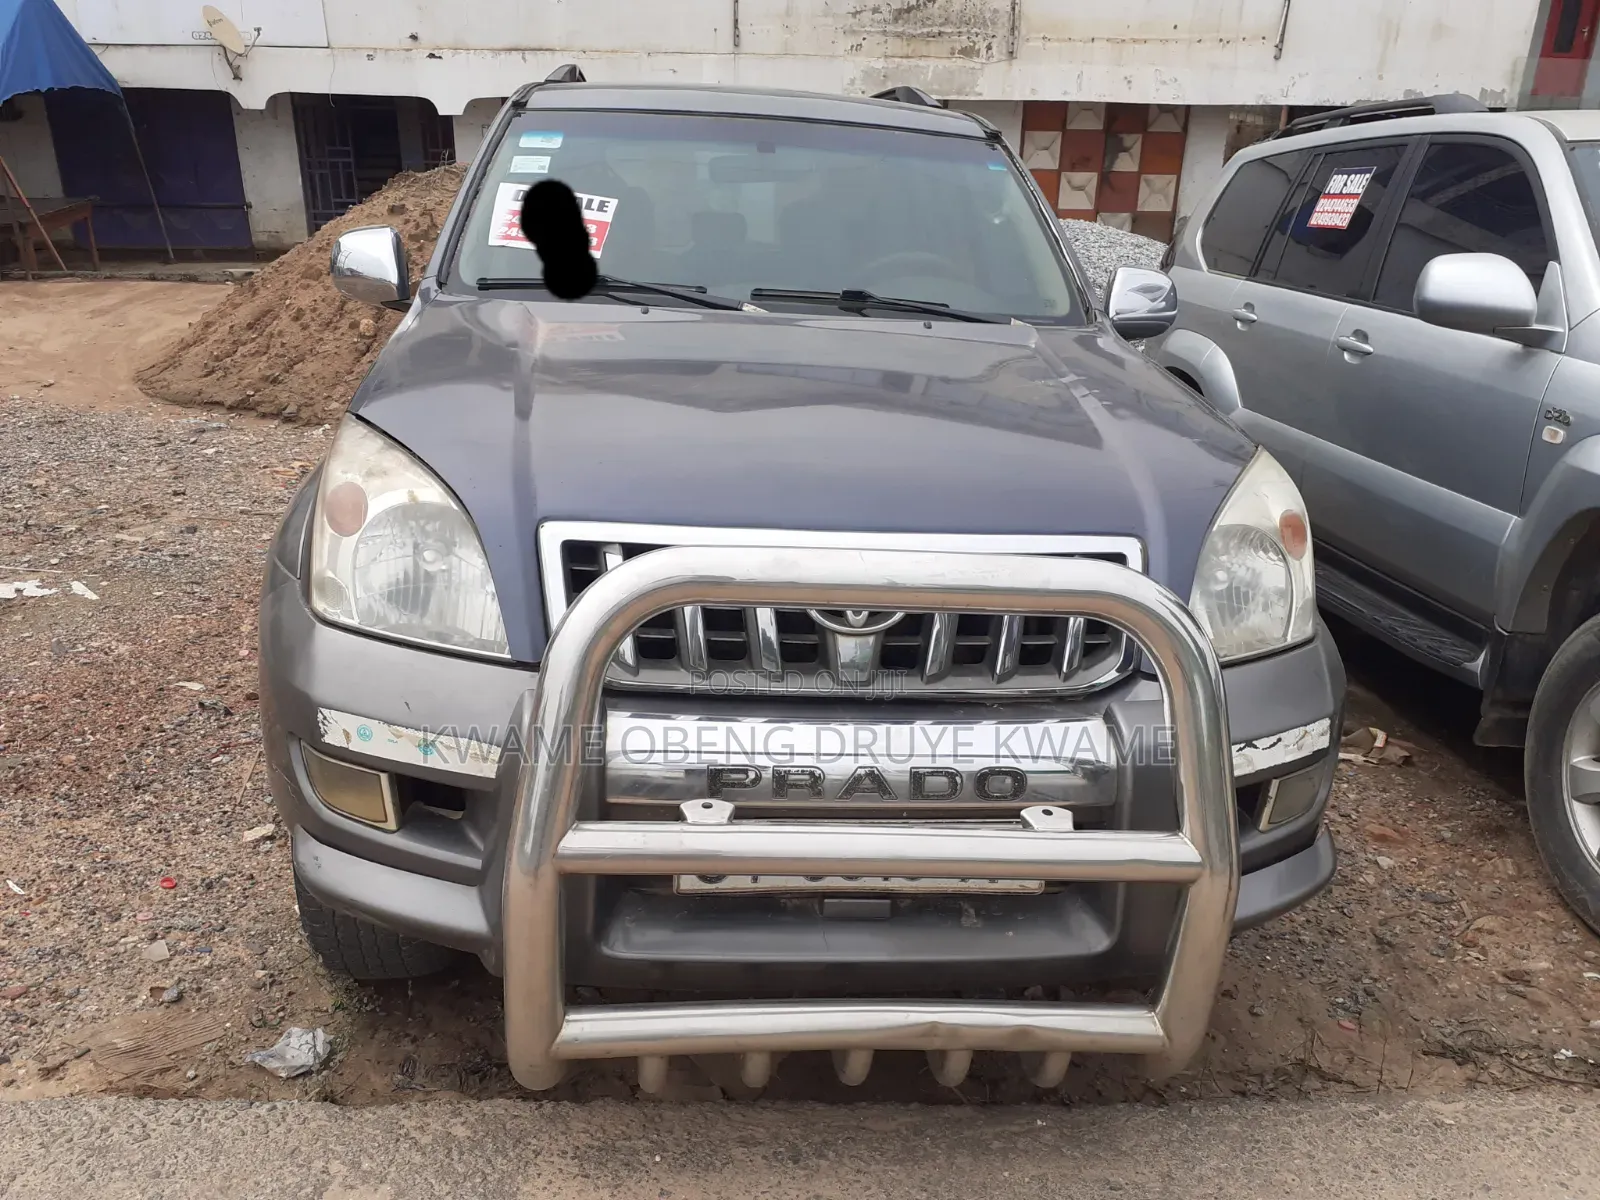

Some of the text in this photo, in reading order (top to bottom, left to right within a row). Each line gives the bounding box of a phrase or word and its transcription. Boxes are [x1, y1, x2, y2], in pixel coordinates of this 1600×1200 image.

[1324, 173, 1371, 194] FOR SALE
[706, 764, 1028, 801] PRADO
